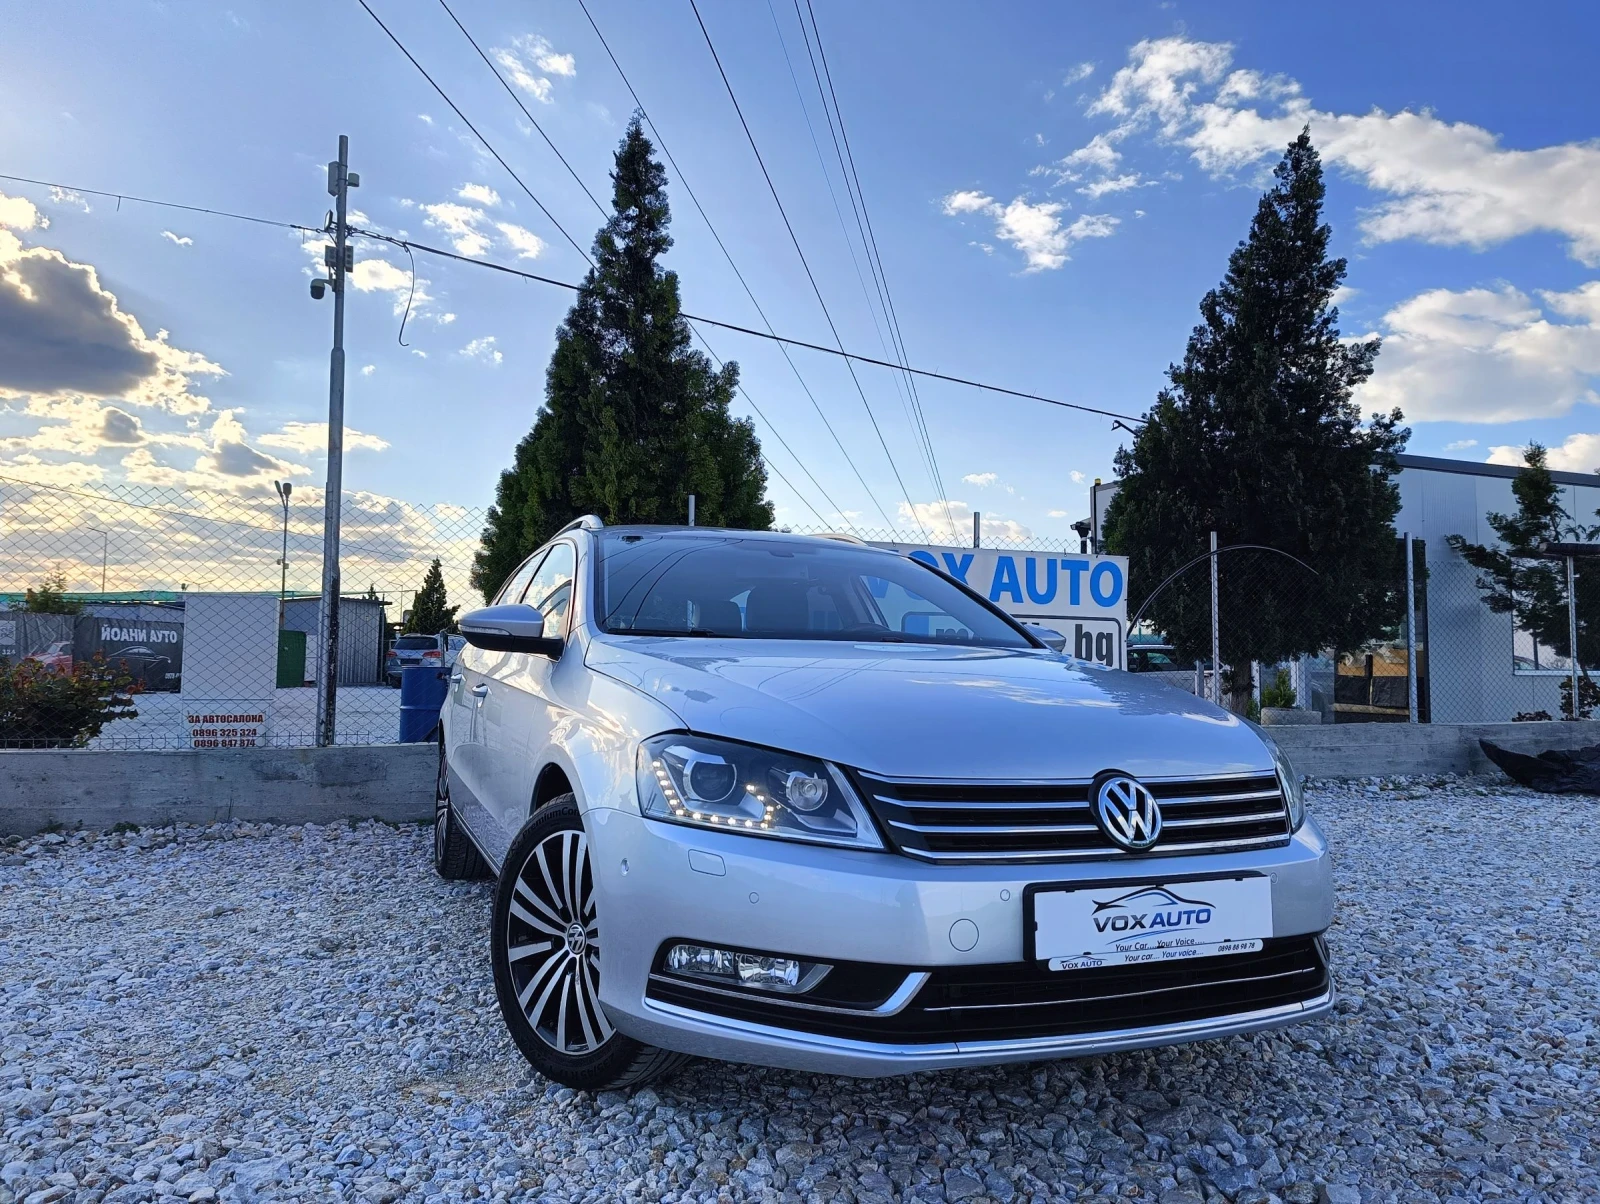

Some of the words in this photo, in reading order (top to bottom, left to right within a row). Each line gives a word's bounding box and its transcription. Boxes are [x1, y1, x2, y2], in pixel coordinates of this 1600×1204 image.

[989, 556, 1124, 608] AUTO
[101, 624, 147, 642] ЙОАНИ
[150, 629, 178, 644] АУТО
[188, 714, 201, 724] ЗА
[202, 714, 264, 724] АВТОСАЛОНА
[192, 728, 218, 737] 0896
[219, 728, 238, 737] 325
[239, 728, 257, 737] 324
[193, 739, 219, 748] 0896
[221, 739, 238, 748] 847
[1093, 913, 1148, 933] VOX
[1148, 908, 1212, 929] AUTO
[1115, 943, 1133, 952] Your
[1124, 954, 1141, 962] Your
[1162, 951, 1178, 959] Your
[1061, 962, 1079, 970] VOX
[1080, 960, 1103, 968] AUTO
